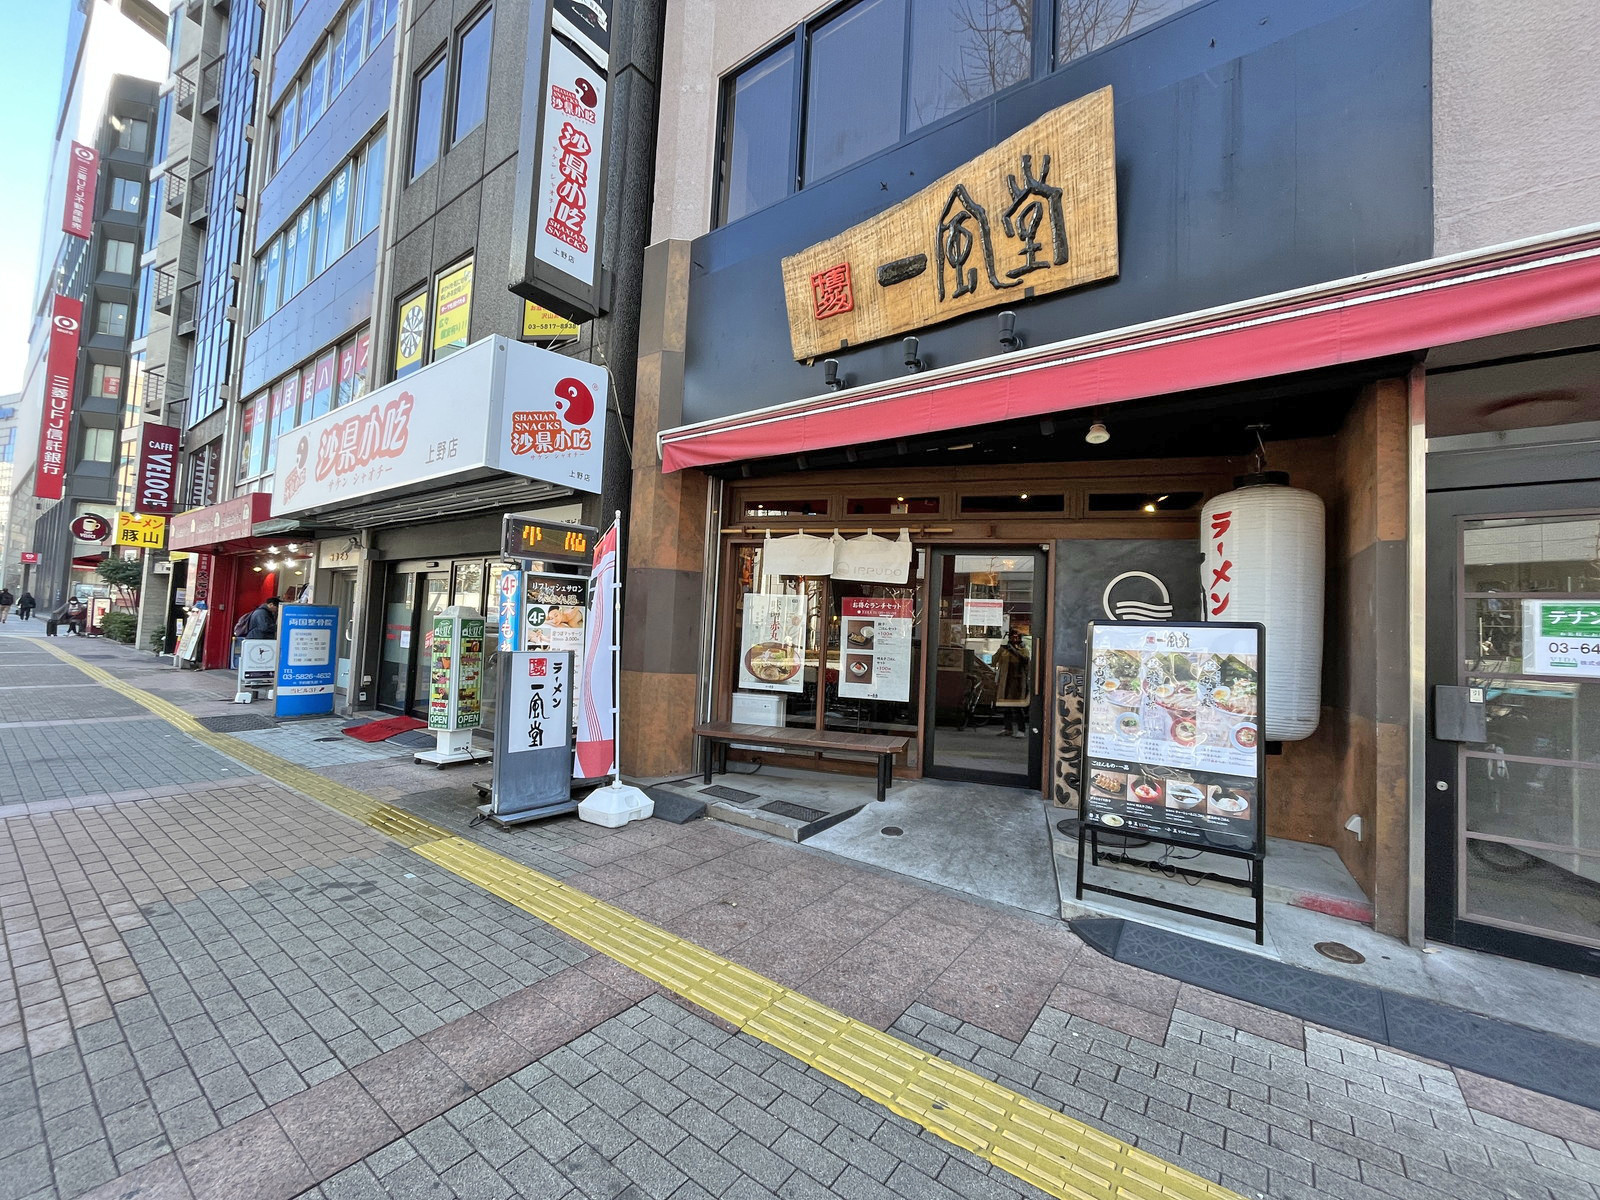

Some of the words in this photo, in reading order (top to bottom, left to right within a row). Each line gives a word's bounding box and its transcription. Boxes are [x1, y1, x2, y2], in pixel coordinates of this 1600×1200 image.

[546, 226, 588, 253] SNACKS
[549, 219, 586, 242] SHAXIAN
[876, 153, 1069, 303] 一風堂
[42, 374, 70, 475] 三菱UFJ信託銀行
[514, 413, 555, 421] SHAXIAN
[514, 421, 560, 432] SNACKS
[316, 394, 414, 481] 沙県小吃
[512, 430, 590, 454] 沙県小吃
[425, 437, 459, 465] 上野店
[142, 453, 173, 508] VELOCE
[120, 515, 164, 530] ラーメン
[121, 528, 160, 545] 豚山
[853, 566, 902, 577] IPPUDO
[1209, 510, 1234, 617] ラーメン
[502, 574, 516, 596] 4F
[528, 611, 545, 625] 4F
[1548, 642, 1600, 655] 03-64
[552, 661, 563, 709] ラーメン
[430, 715, 448, 725] OPEN
[458, 714, 480, 724] OPEN
[528, 683, 550, 748] 一風堂
